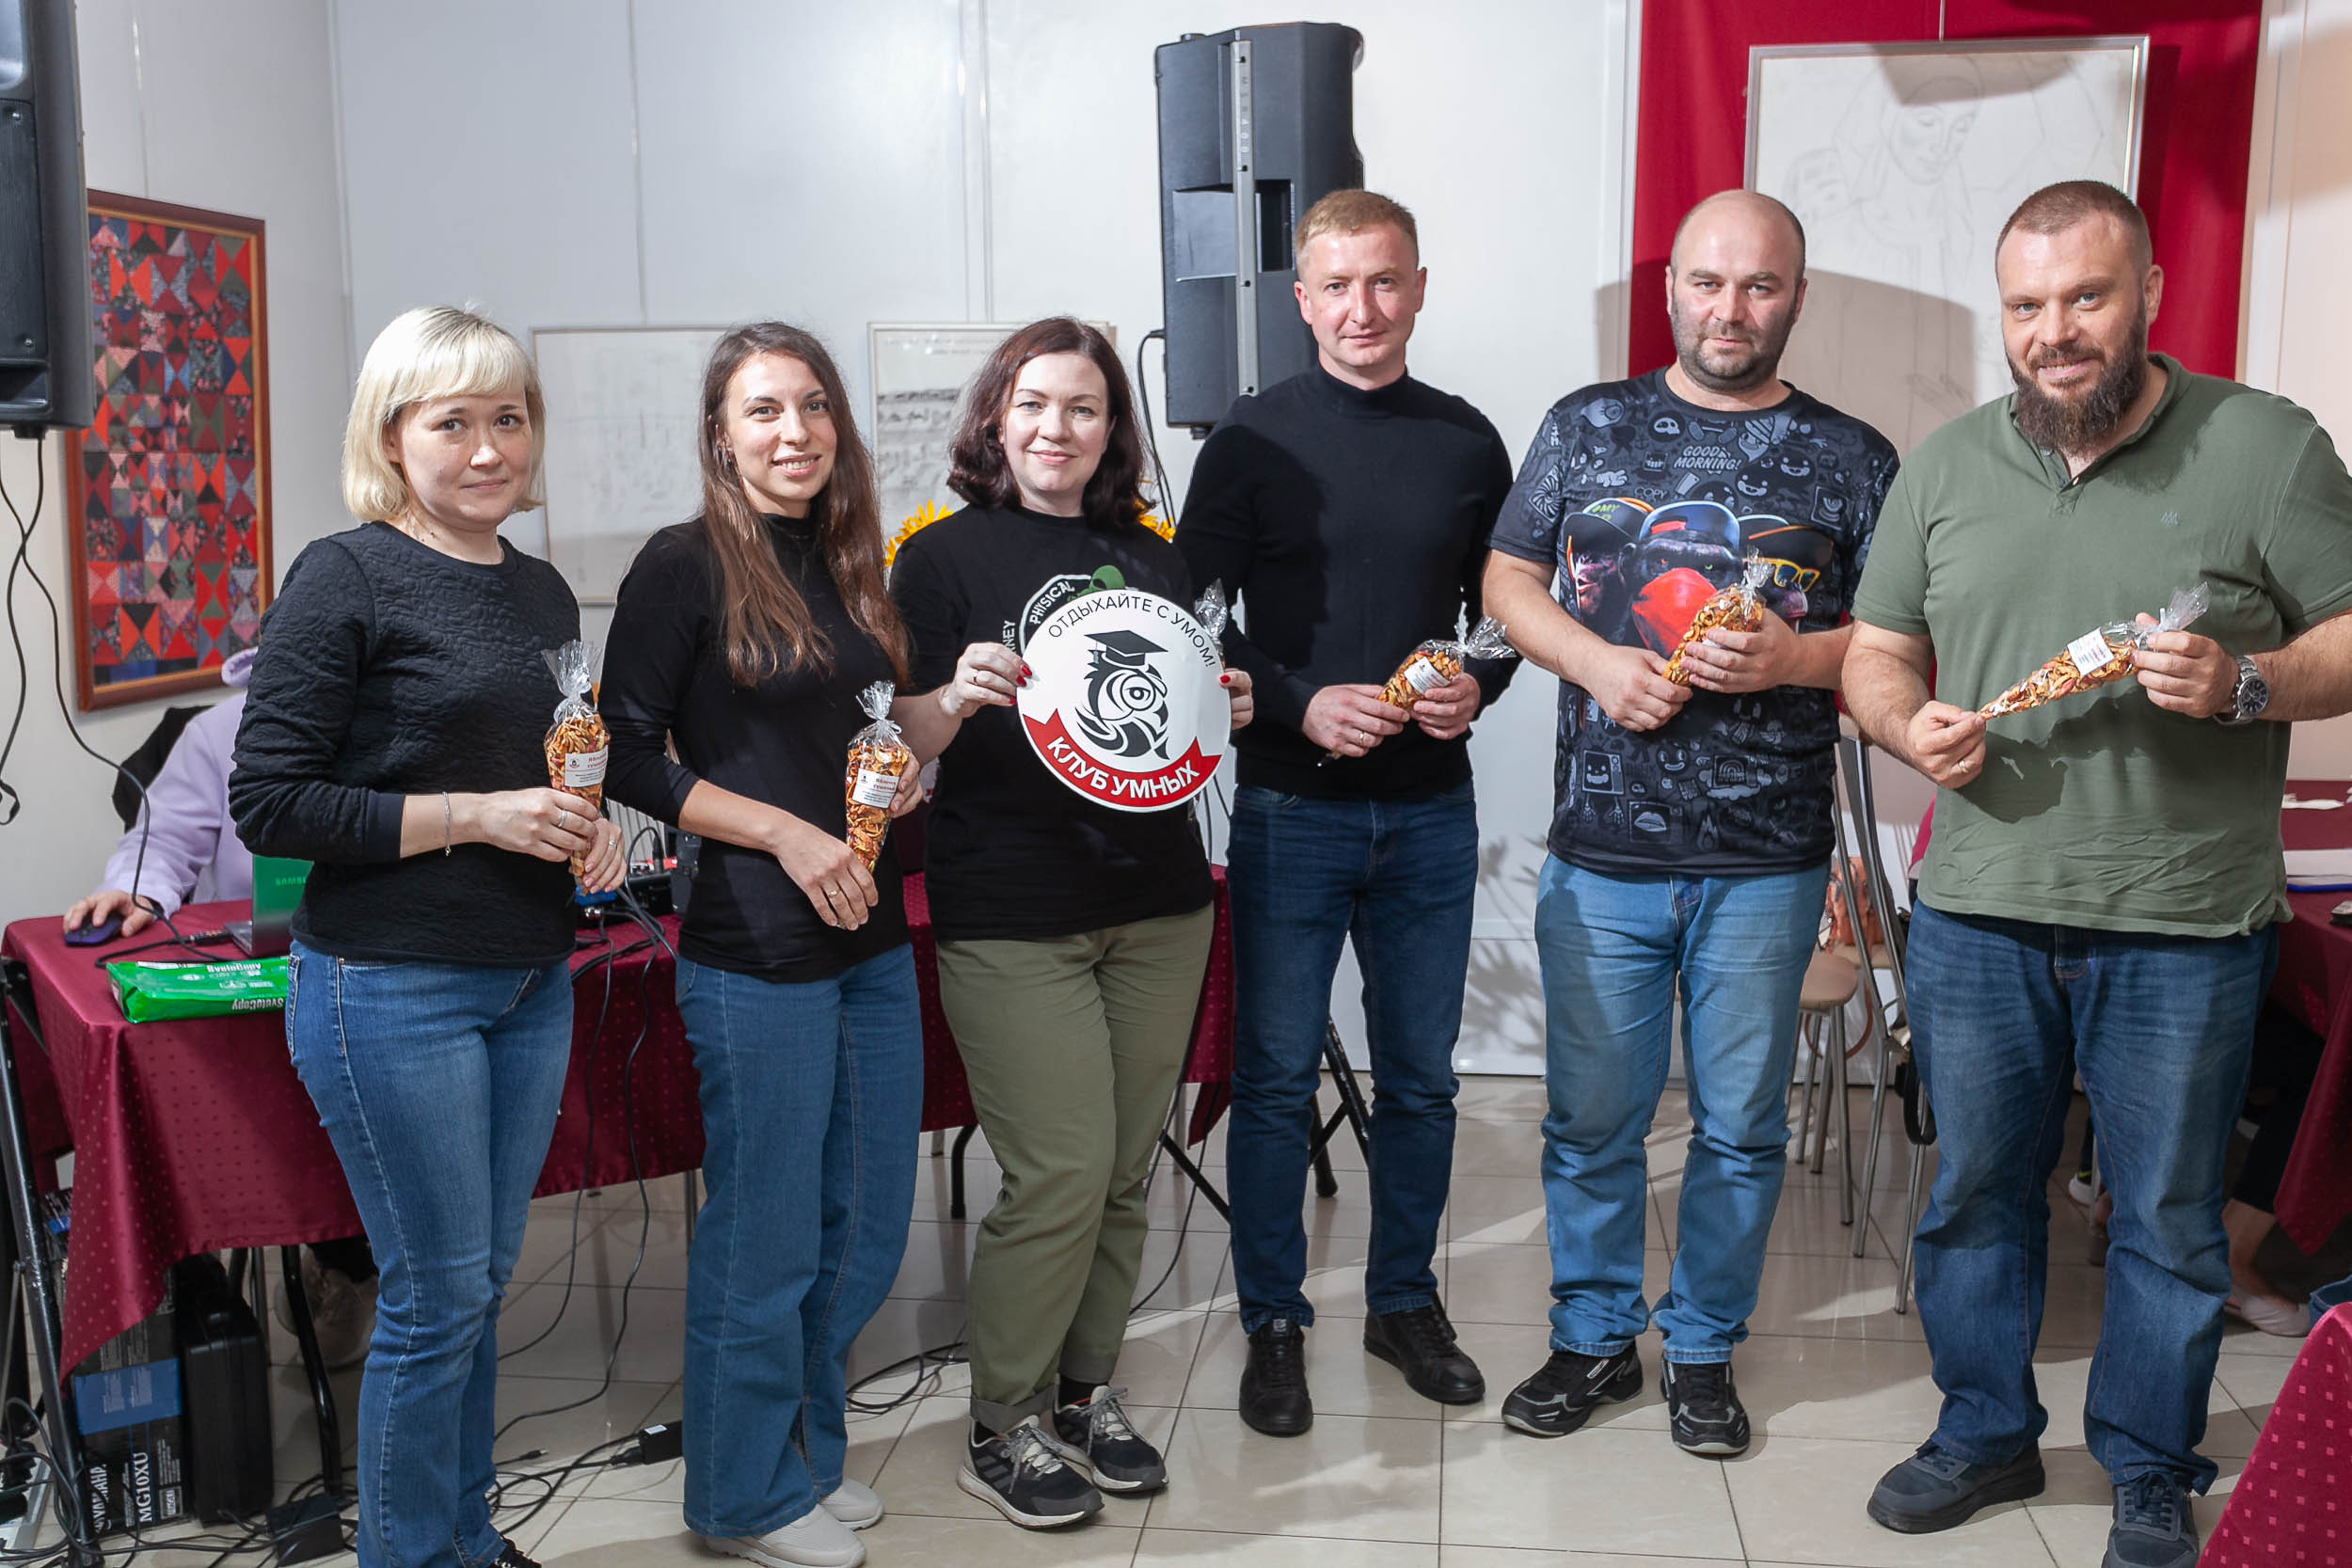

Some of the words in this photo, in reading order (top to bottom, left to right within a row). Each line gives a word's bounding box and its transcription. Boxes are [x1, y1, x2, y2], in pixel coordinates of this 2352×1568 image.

[1674, 457, 1742, 470] MORNING!
[1683, 445, 1721, 458] GOOD
[1029, 580, 1075, 625] PHYSICAL
[1048, 593, 1152, 638] ОТДЫХАЙТЕ
[1156, 605, 1169, 619] С
[1170, 612, 1216, 668] УМОМ!
[1046, 736, 1109, 791] КЛУБ
[1110, 759, 1200, 800] УМНЫХ
[133, 1451, 153, 1523] MG10XU
